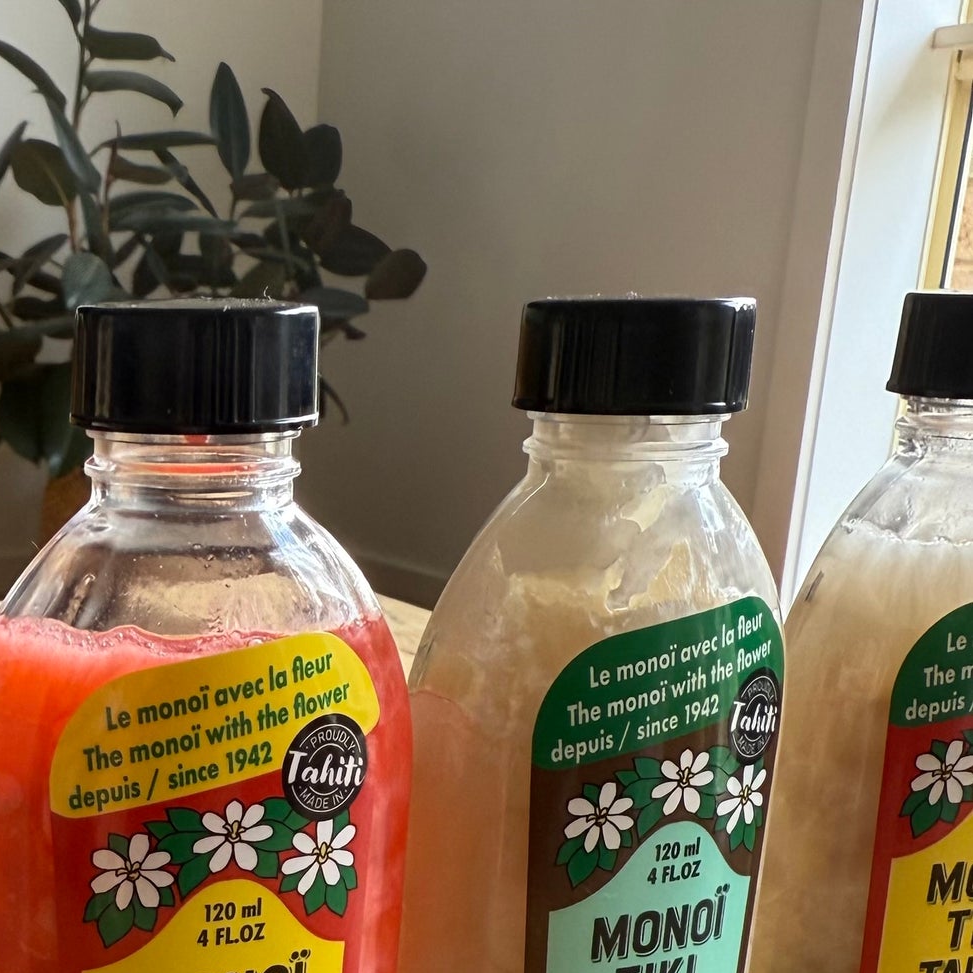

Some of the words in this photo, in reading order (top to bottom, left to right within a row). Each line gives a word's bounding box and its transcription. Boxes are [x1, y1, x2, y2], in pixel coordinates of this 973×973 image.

[590, 666, 610, 688] Le
[617, 646, 677, 682] monoï
[681, 636, 718, 663] avec
[721, 624, 734, 647] la
[738, 612, 763, 640] fleur
[947, 632, 967, 652] Le
[567, 704, 601, 727] The
[607, 681, 667, 718] monoï
[672, 672, 706, 698] with
[711, 661, 733, 684] the
[737, 640, 771, 674] flower
[924, 664, 955, 687] The
[106, 707, 130, 731] Le
[138, 686, 209, 724] monoï
[214, 678, 264, 706] avec
[269, 665, 287, 691] la
[292, 652, 332, 683] fleur
[905, 691, 965, 722] depuis
[83, 747, 123, 771] The
[130, 725, 201, 765] monoï
[206, 715, 252, 745] with
[257, 703, 288, 731] the
[293, 682, 350, 720] flower
[551, 731, 614, 763] depuis
[637, 712, 678, 740] since
[684, 694, 719, 725] 1942
[731, 701, 777, 733] Tahiti
[310, 729, 355, 750] PROUDLY
[69, 776, 141, 812] depuis
[168, 762, 219, 790] since
[226, 741, 273, 774] 1942
[287, 750, 366, 786] Tahiti
[300, 788, 329, 808] MADE
[333, 791, 344, 805] IN
[655, 842, 680, 862] 120
[684, 837, 701, 856] ml
[647, 868, 657, 885] 4
[662, 860, 701, 883] FL.OZ
[205, 902, 236, 922] 120
[241, 897, 262, 918] ml
[590, 883, 730, 963] MONOÏ
[197, 930, 208, 947] 4
[216, 923, 266, 946] FL.OZ
